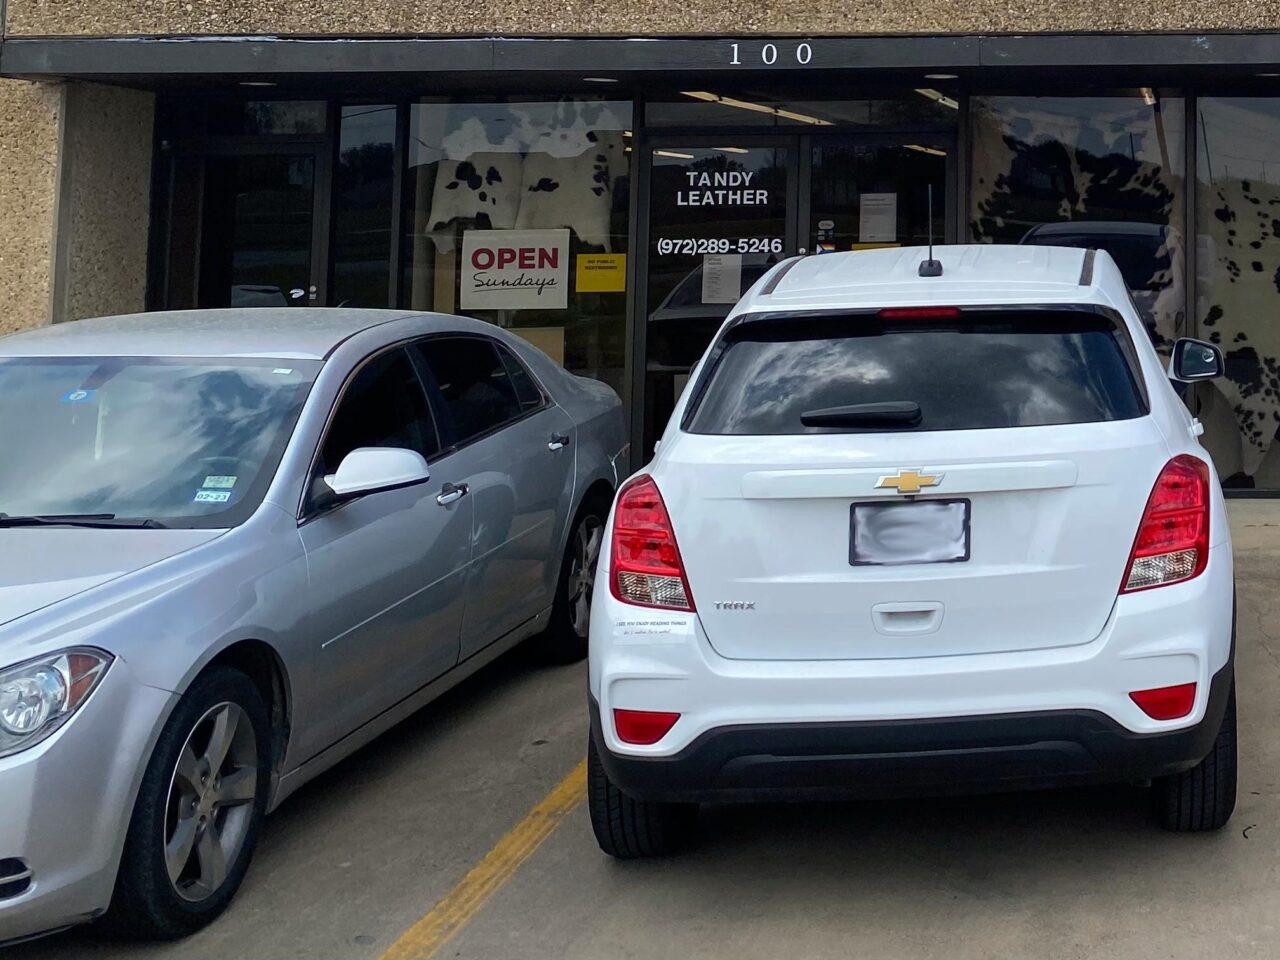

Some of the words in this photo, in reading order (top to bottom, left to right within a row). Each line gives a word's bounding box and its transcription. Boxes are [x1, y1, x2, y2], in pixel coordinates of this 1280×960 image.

[729, 43, 813, 65] 100
[686, 171, 754, 187] TANDY
[677, 190, 769, 206] LEATHER
[657, 238, 783, 256] (972)289-5246
[471, 247, 559, 270] OPEN
[473, 271, 558, 296] Sundays
[713, 600, 756, 611] TRAX
